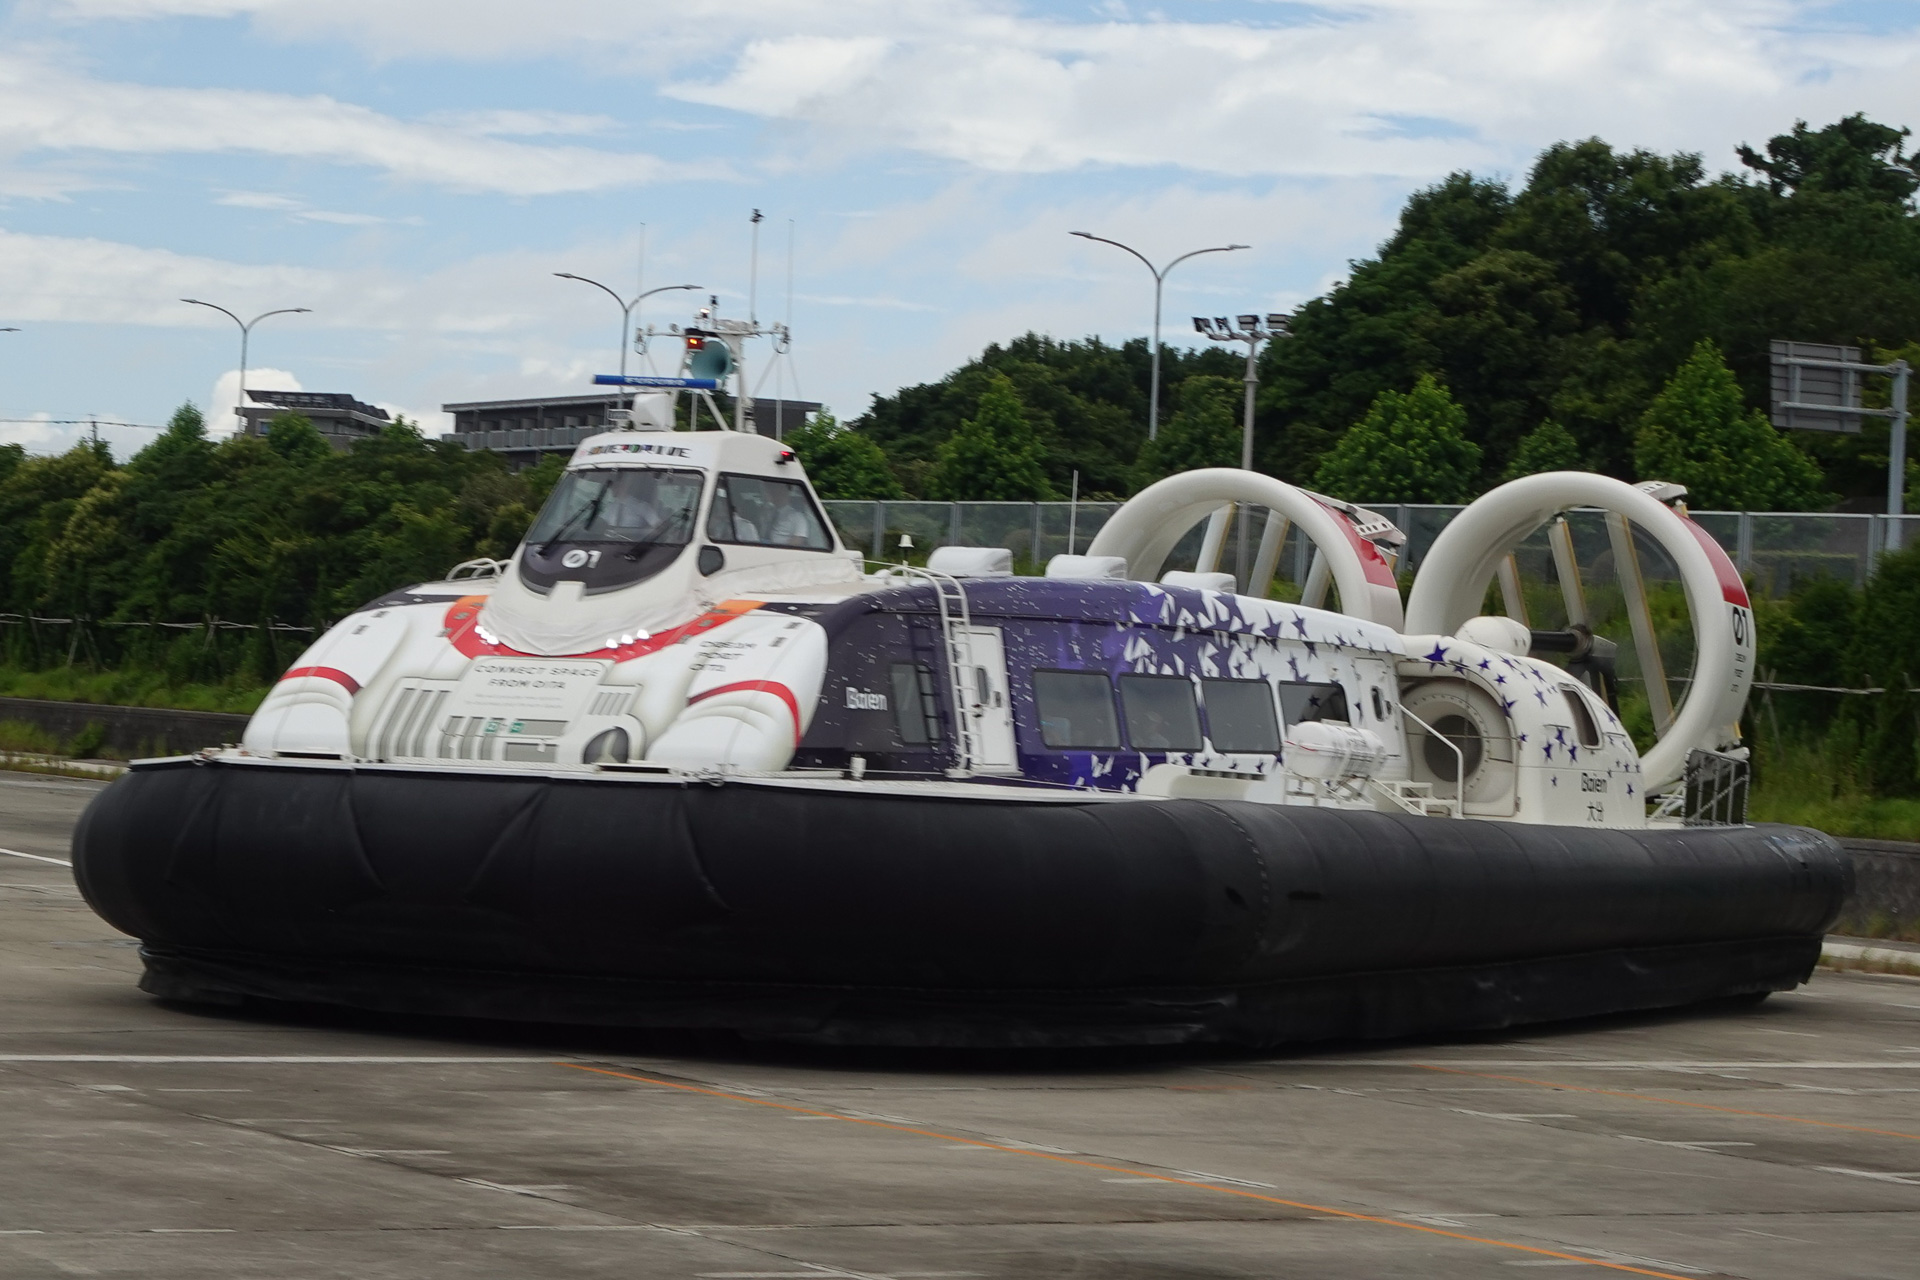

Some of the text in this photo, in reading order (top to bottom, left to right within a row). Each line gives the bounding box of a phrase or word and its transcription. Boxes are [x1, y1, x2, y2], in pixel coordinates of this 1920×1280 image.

[562, 549, 602, 569] 01
[1732, 606, 1750, 648] 01
[474, 664, 602, 677] CONNECT SPACE
[487, 678, 529, 688] FROM
[845, 686, 888, 711] Baien
